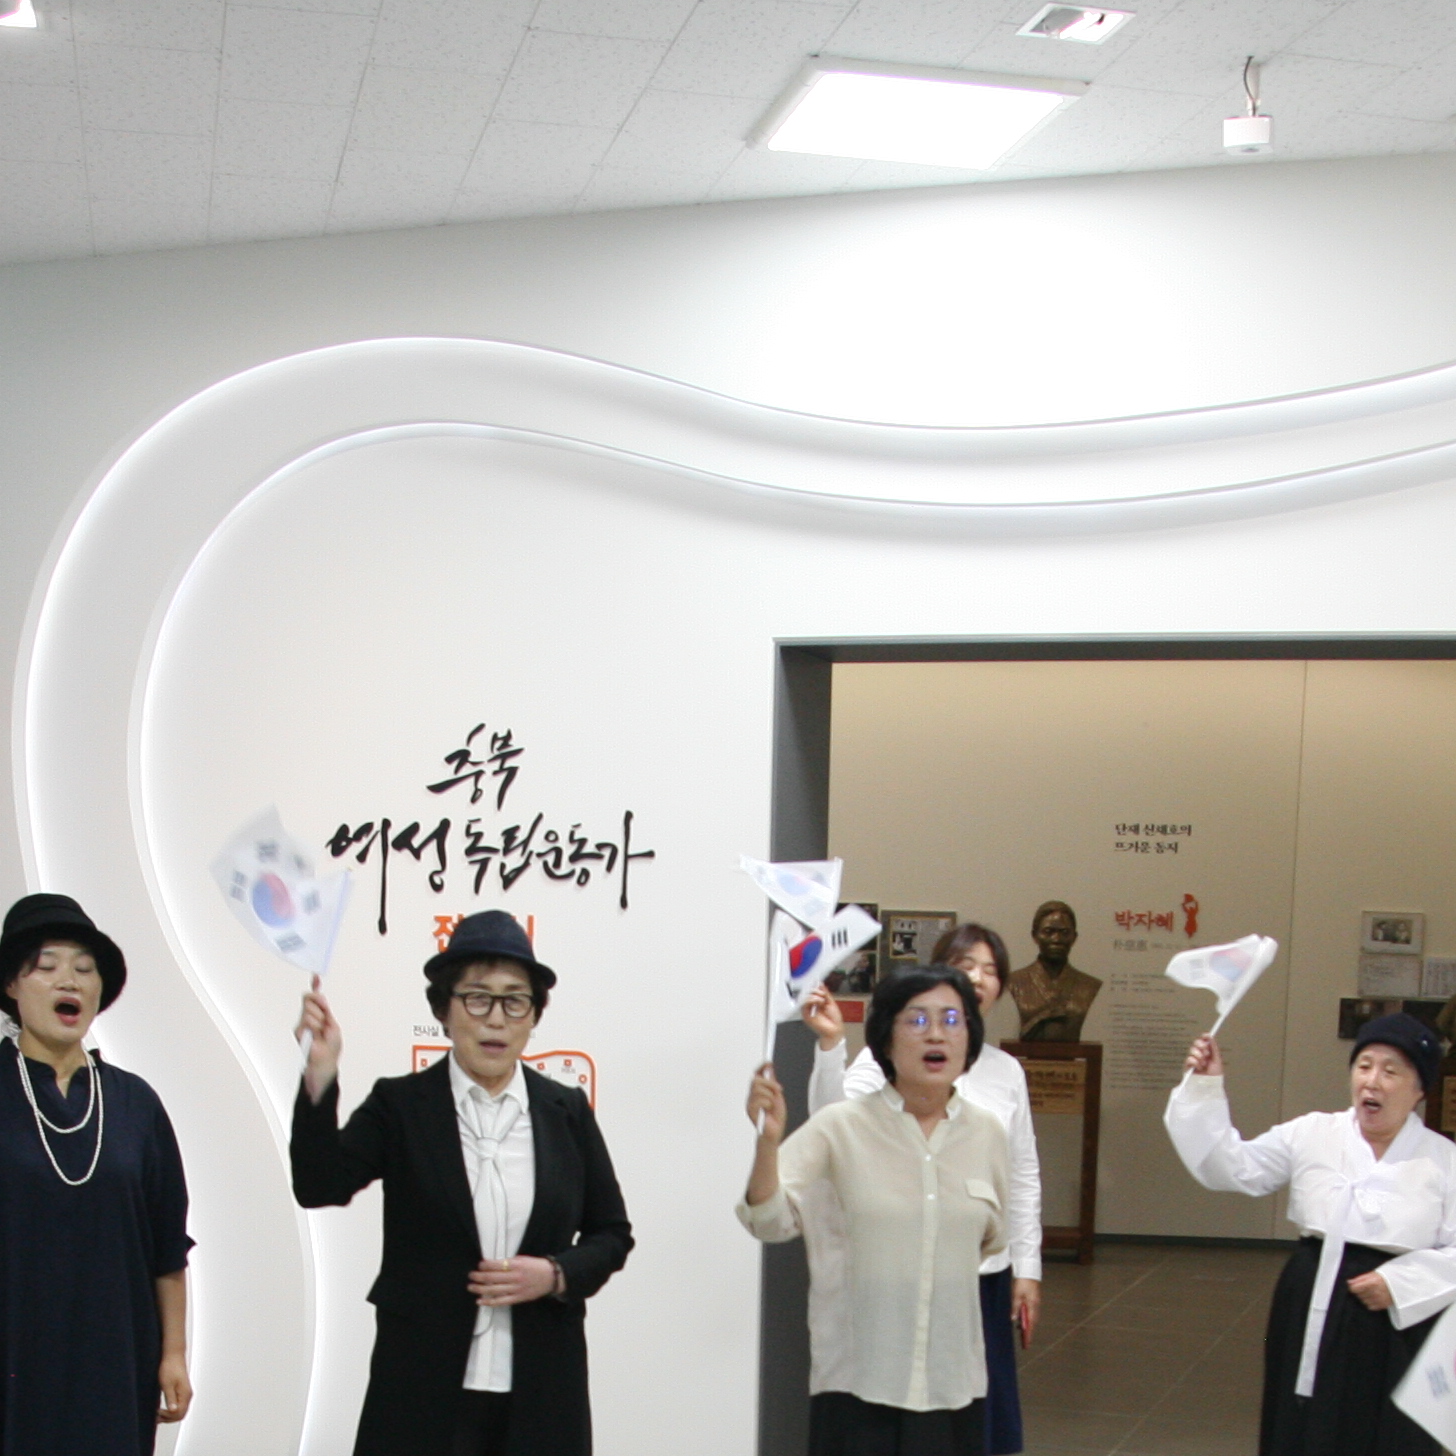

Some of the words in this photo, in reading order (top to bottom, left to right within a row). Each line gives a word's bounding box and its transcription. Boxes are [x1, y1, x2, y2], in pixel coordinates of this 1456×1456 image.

[426, 723, 524, 810] 충북
[1115, 823, 1140, 836] 단재
[1114, 910, 1174, 932] 박자혜
